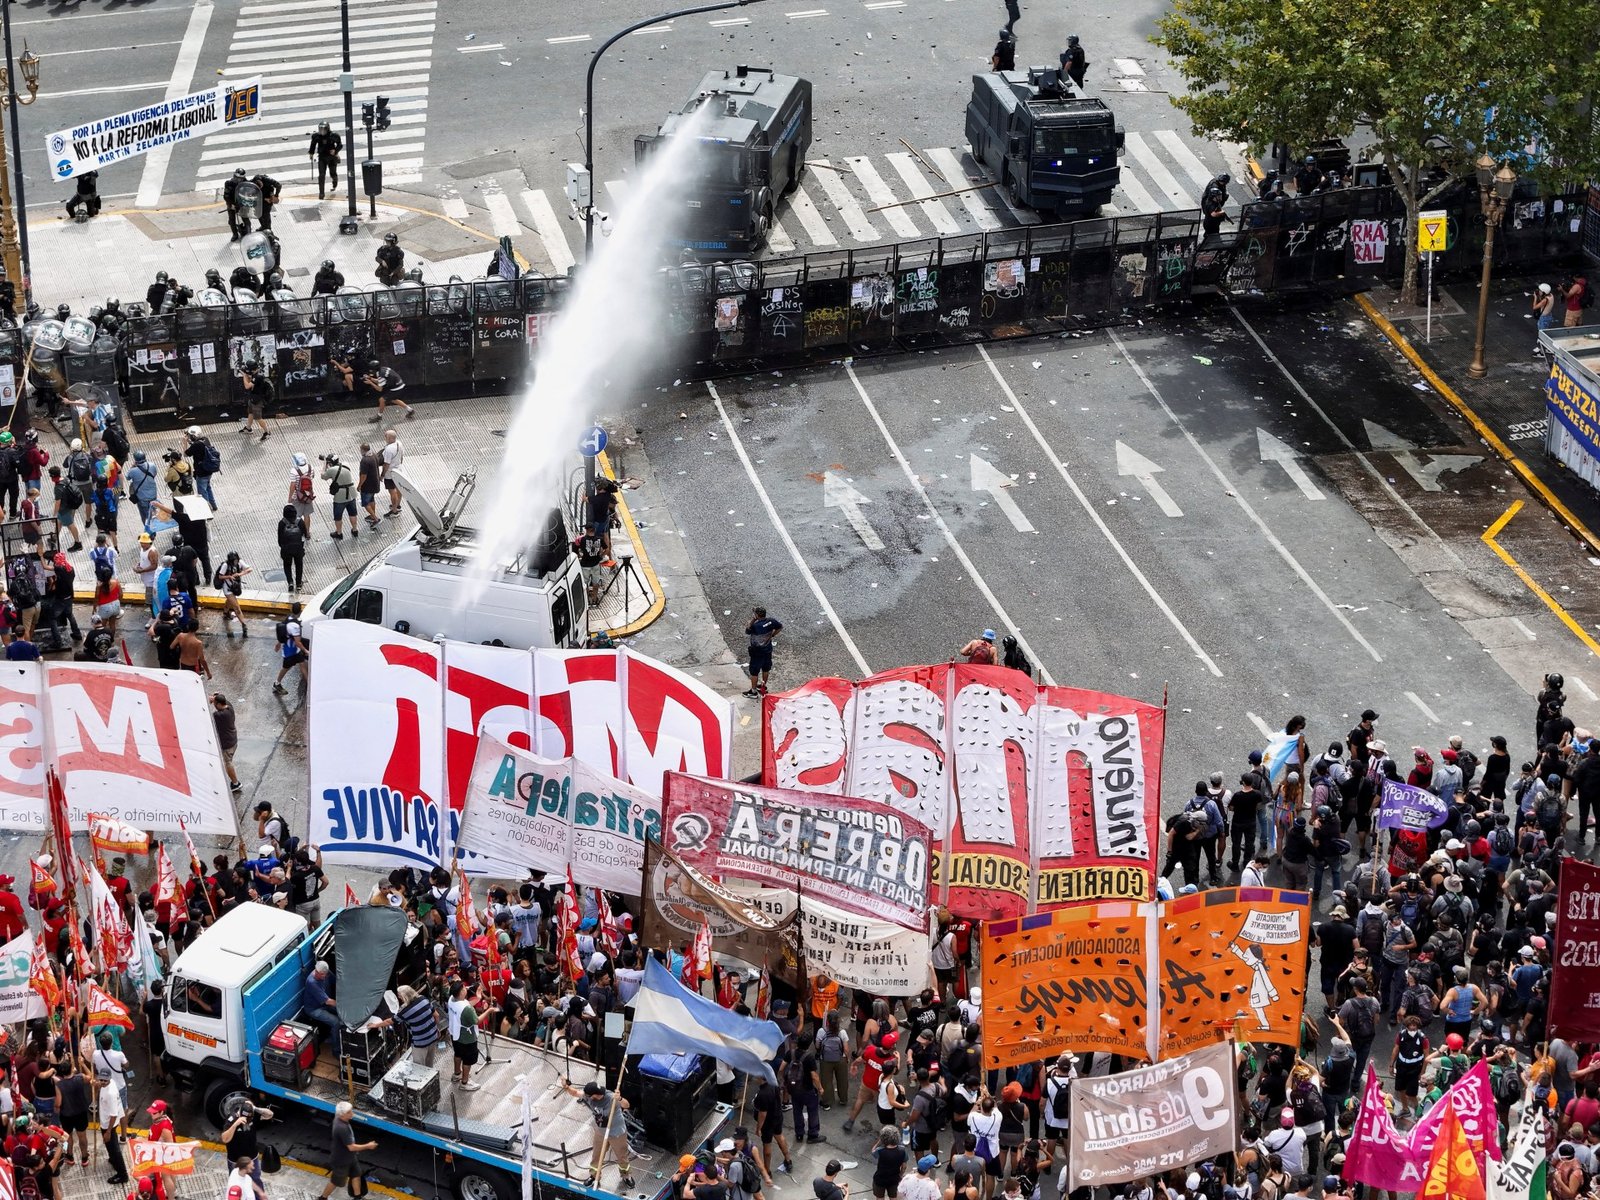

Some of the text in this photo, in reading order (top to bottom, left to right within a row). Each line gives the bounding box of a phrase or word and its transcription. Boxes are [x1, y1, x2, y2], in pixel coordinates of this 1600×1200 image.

[72, 126, 89, 140] POR
[91, 124, 102, 135] LA
[104, 114, 131, 130] PLENA
[171, 99, 186, 113] DEL
[196, 94, 206, 106] 14
[72, 140, 90, 161] NO
[91, 137, 99, 156] A
[100, 132, 115, 152] LA
[117, 116, 172, 148] REFORMA
[171, 103, 218, 132] LABORAL
[136, 129, 190, 152] ZELARAYAN
[478, 317, 488, 325] EL
[478, 330, 490, 339] EL
[1550, 363, 1597, 422] FUERZA
